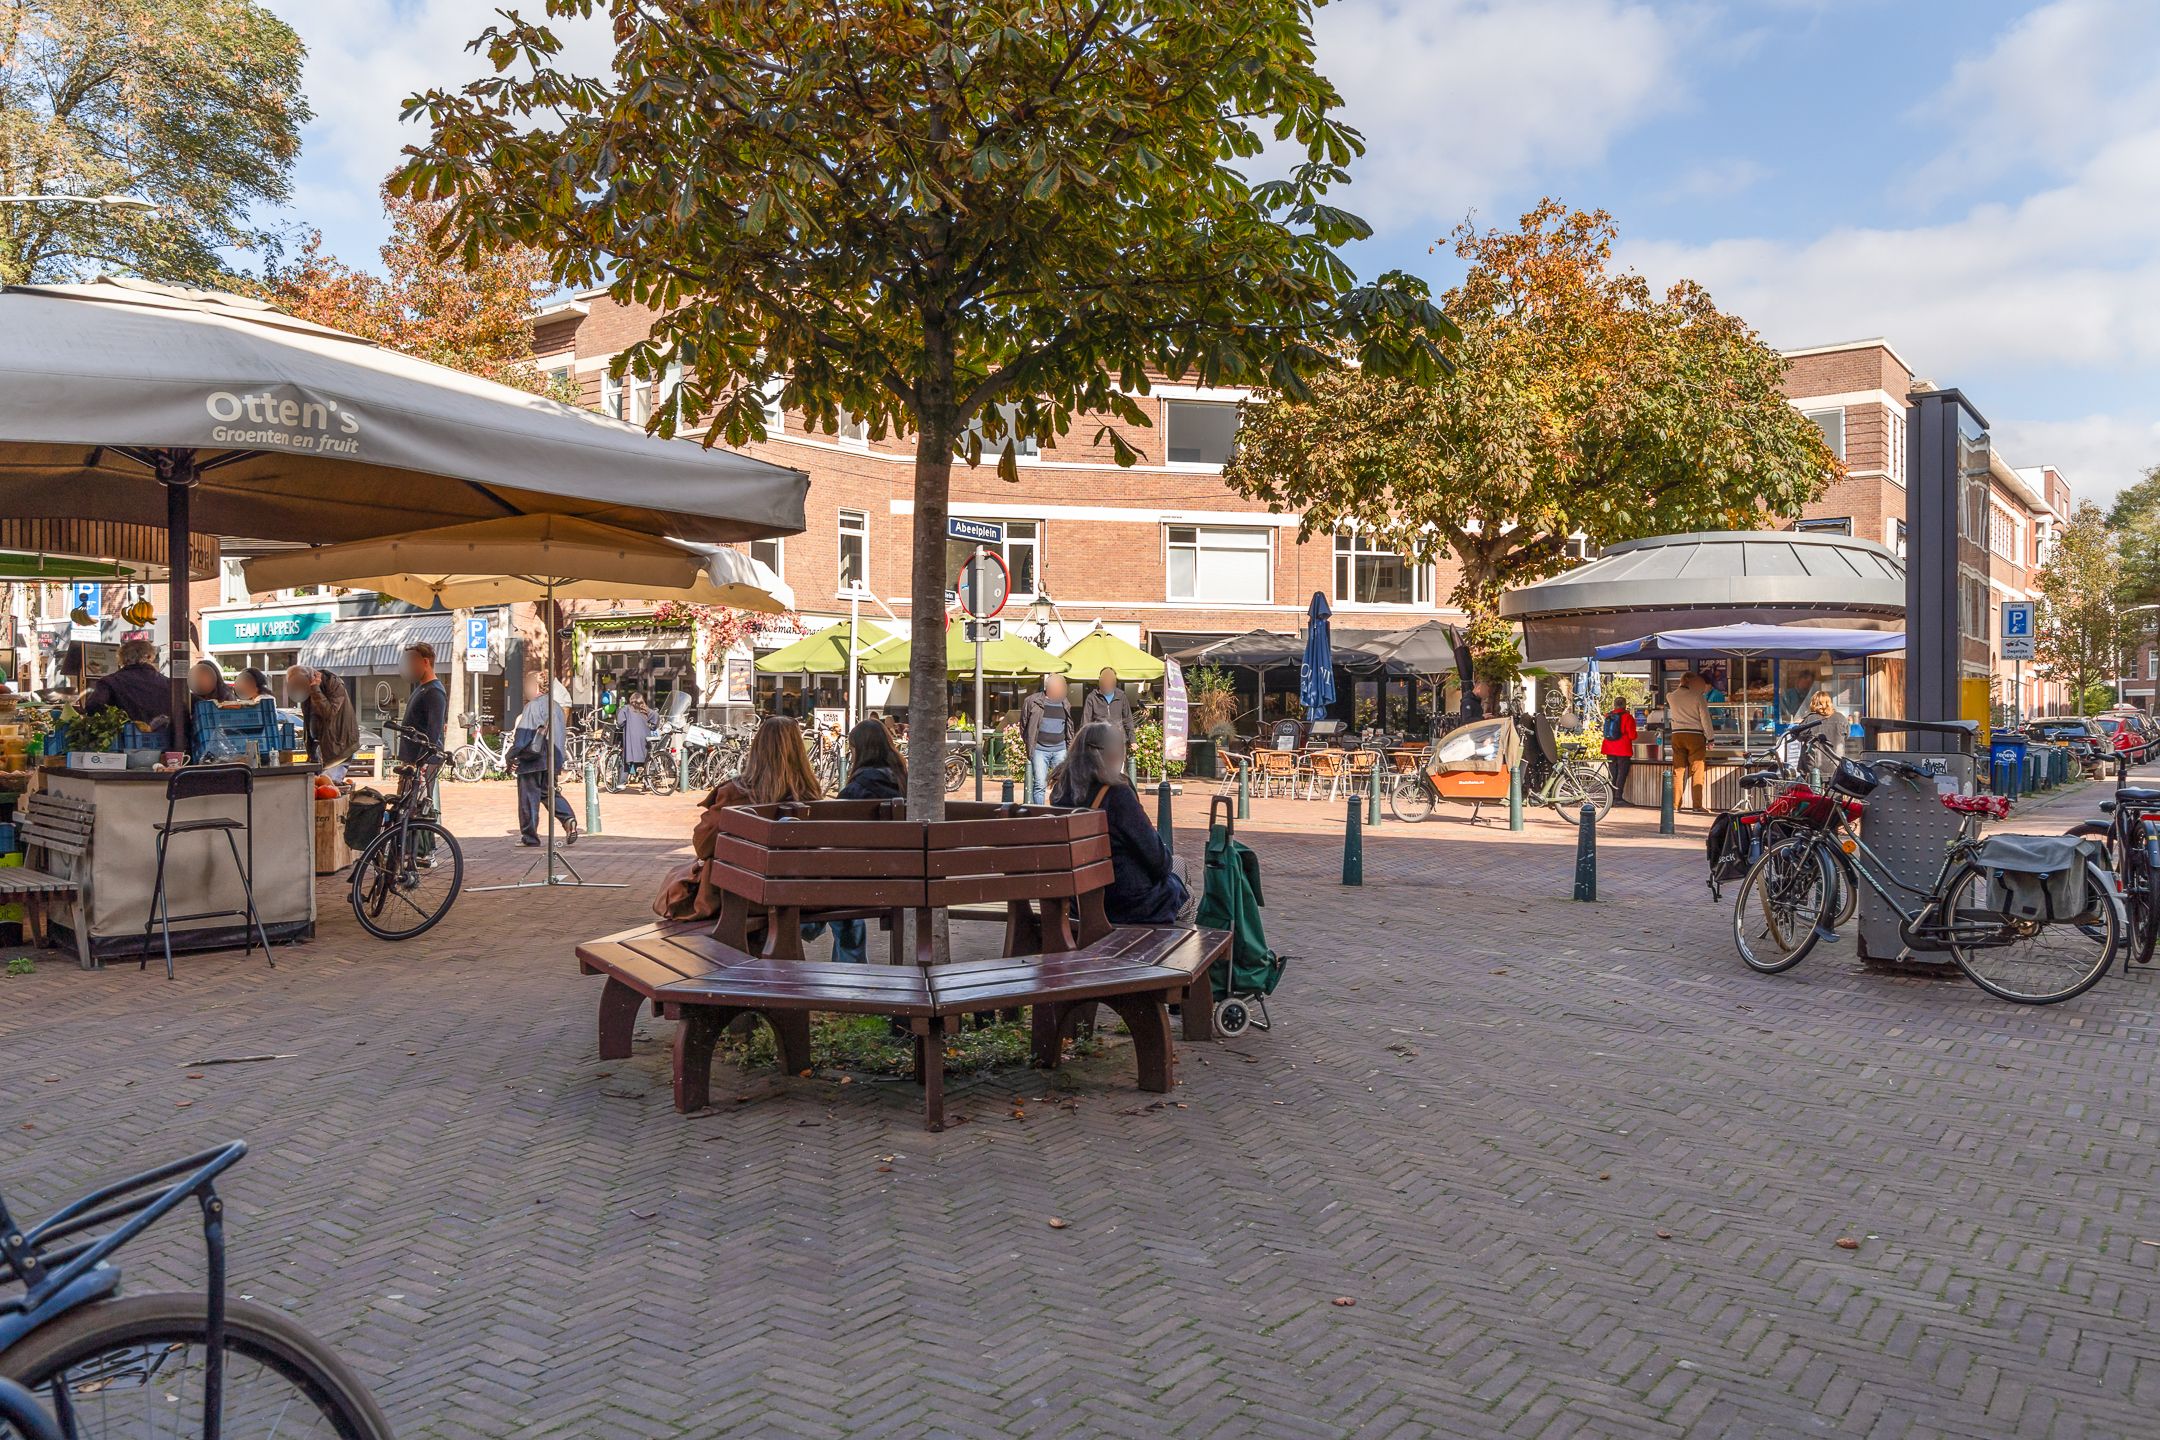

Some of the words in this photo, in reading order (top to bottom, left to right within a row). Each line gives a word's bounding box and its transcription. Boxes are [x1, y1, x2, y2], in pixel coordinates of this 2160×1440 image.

[206, 391, 360, 434] Otten's
[212, 425, 289, 446] Groenten
[292, 433, 314, 448] en
[316, 434, 360, 454] fruit
[955, 521, 997, 538] Abeelplein
[2012, 612, 2024, 624] P
[234, 622, 260, 638] TEAM
[261, 619, 301, 636] KAPPERS
[471, 621, 484, 637] P
[1851, 858, 1884, 892] BATAVUS
